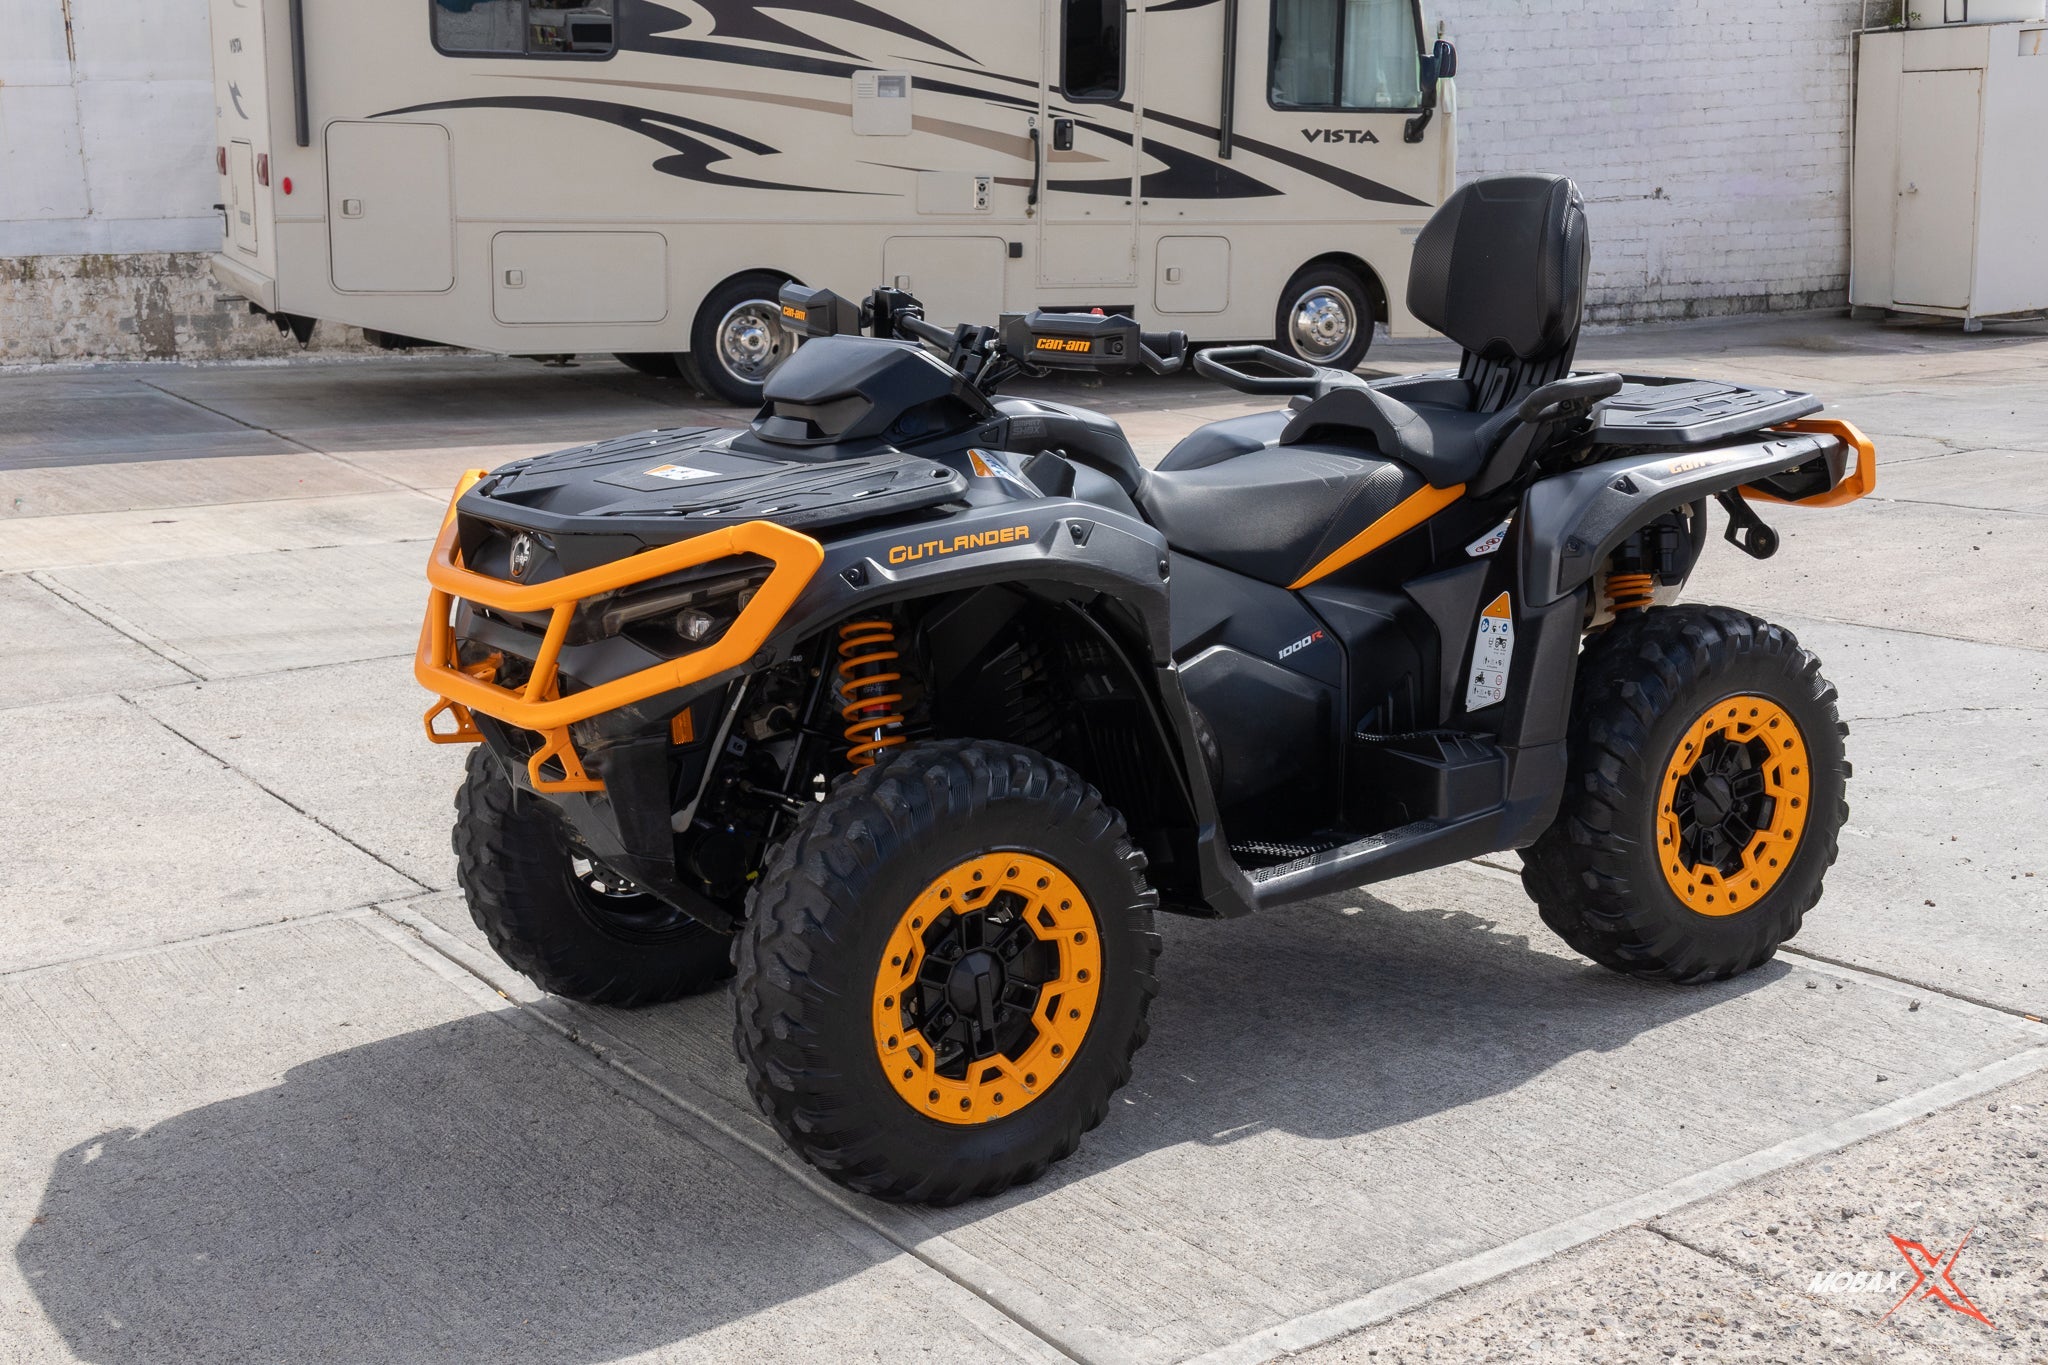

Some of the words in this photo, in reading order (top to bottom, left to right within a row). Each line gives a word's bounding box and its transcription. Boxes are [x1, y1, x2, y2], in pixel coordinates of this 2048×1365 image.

[1301, 128, 1379, 144] VISTA
[783, 305, 806, 321] can-am
[1036, 338, 1091, 352] can-am
[888, 525, 1029, 564] OUTLANDER
[1278, 630, 1323, 660] 1000R
